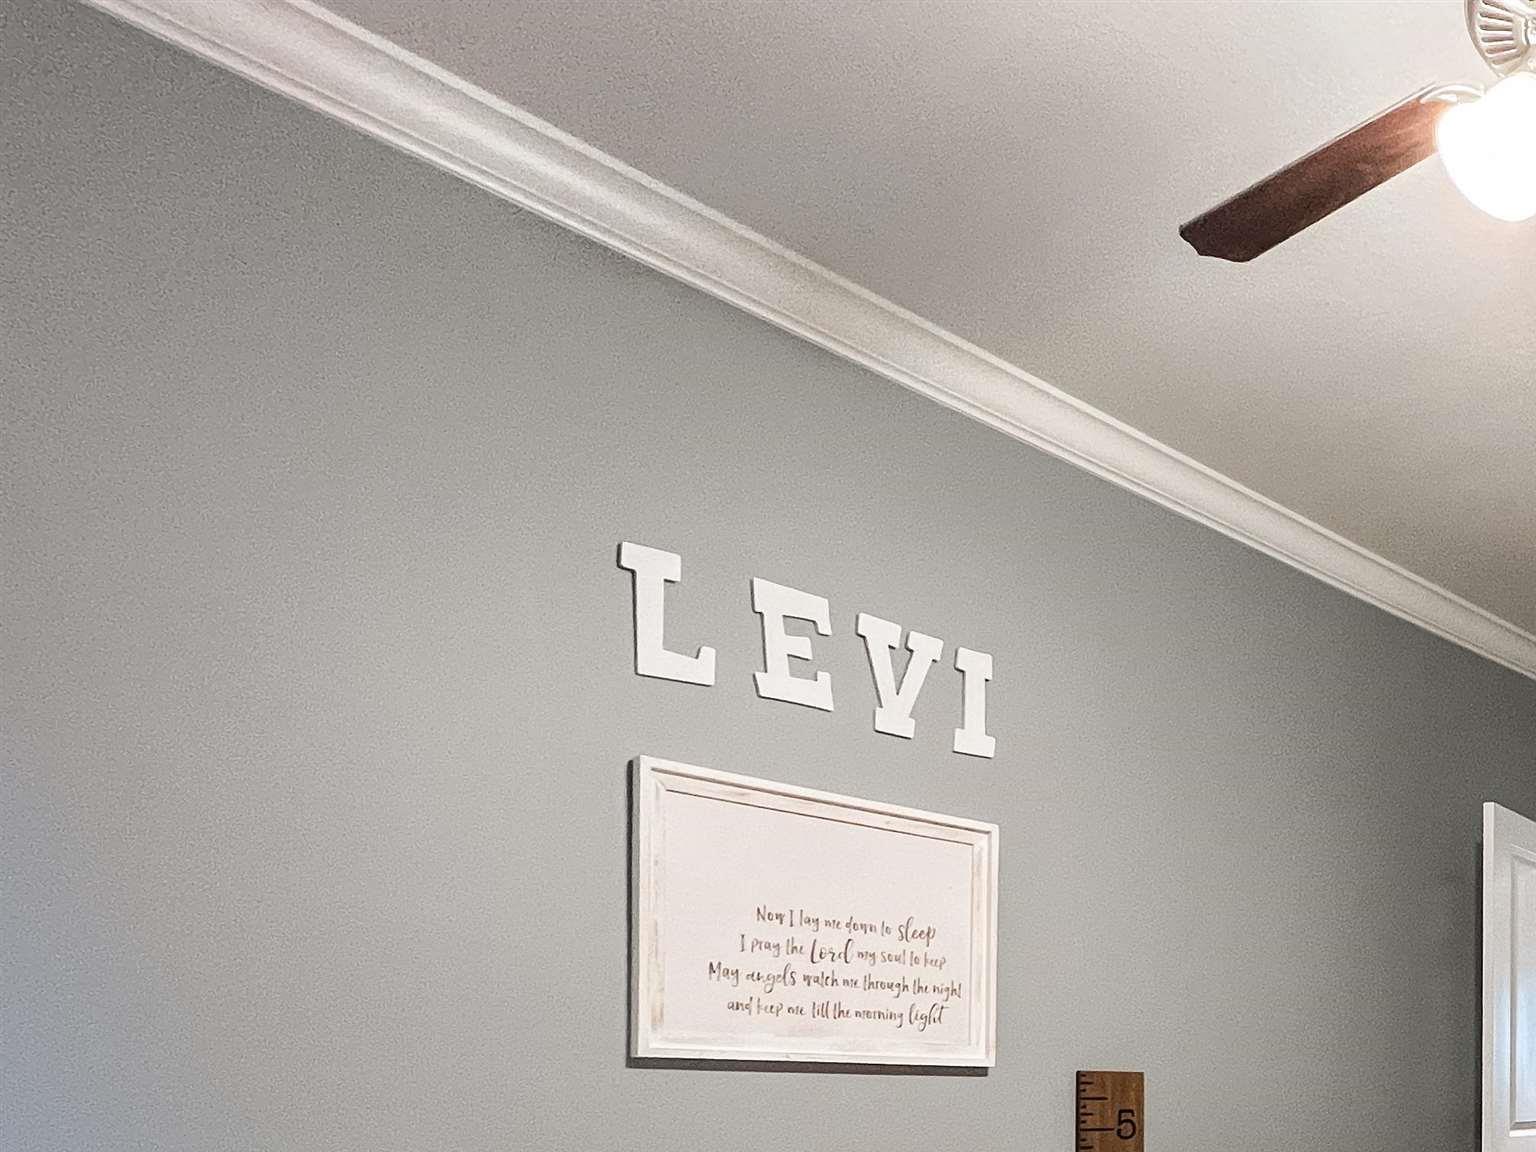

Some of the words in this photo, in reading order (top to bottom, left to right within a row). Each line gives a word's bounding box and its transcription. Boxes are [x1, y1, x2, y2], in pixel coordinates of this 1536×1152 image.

[617, 541, 996, 758] LEVI
[756, 905, 785, 925] Now
[788, 909, 795, 927] I
[800, 909, 819, 932] lay
[824, 919, 841, 930] me
[845, 916, 877, 934] down
[881, 920, 891, 936] to
[898, 916, 936, 947] sleep
[740, 934, 745, 952] I
[751, 938, 780, 958] pray
[786, 936, 803, 955] the
[811, 938, 853, 964] Lord
[857, 951, 875, 967] my
[881, 949, 905, 965] soul
[910, 951, 920, 966] to
[924, 952, 946, 970] keep
[709, 961, 739, 987] May
[746, 963, 797, 993] angels
[803, 970, 839, 987] watch
[842, 978, 860, 988] me
[864, 973, 909, 998] through
[913, 977, 929, 995] the
[933, 980, 962, 1001] night
[727, 996, 752, 1015] and
[757, 998, 783, 1017] keep
[788, 1006, 806, 1016] me
[812, 1000, 829, 1019] till
[833, 1001, 851, 1020] the
[855, 1009, 903, 1028] morning
[909, 1003, 949, 1032] light
[1116, 1108, 1136, 1140] 5
